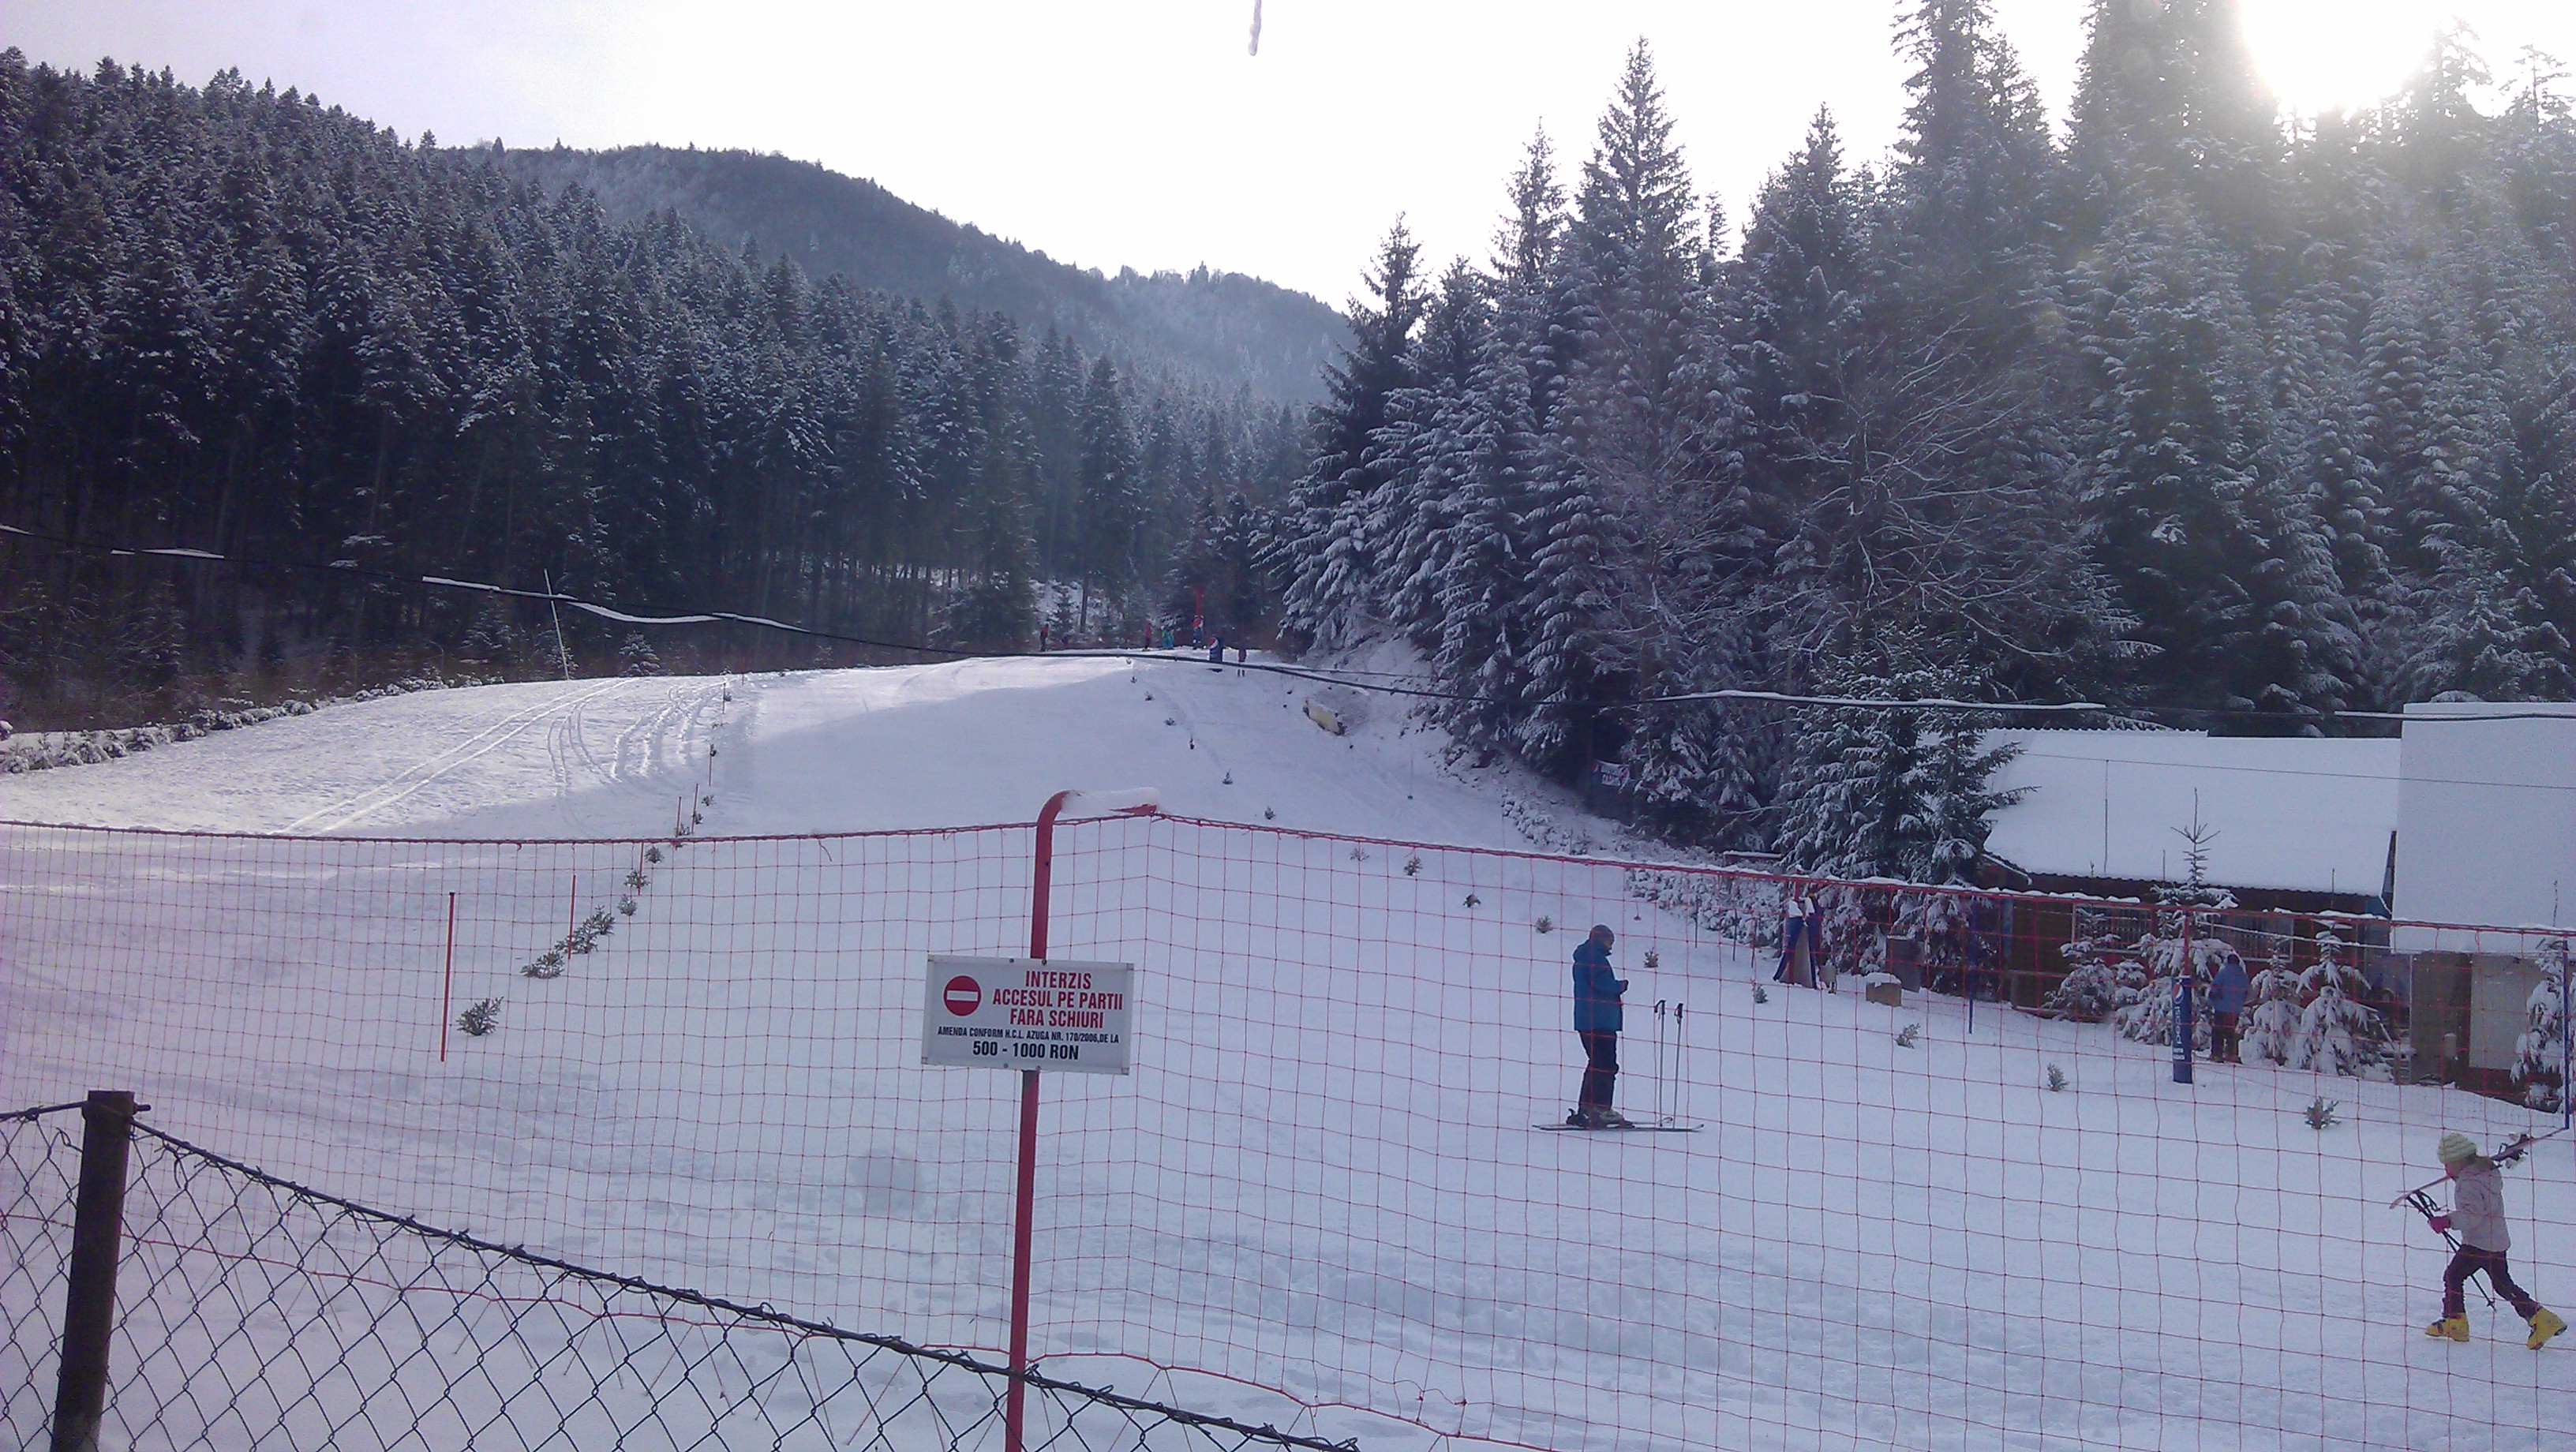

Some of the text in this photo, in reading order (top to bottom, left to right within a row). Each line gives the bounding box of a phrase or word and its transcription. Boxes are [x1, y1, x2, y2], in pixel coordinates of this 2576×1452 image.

[1025, 971, 1091, 990] INTERZIS
[993, 988, 1123, 1010] ACCESUL PE PARTII
[1009, 1009, 1103, 1028] FARA SCHIURI
[938, 1026, 968, 1036] AMENDA
[969, 1027, 1003, 1038] CONFORM
[1005, 1029, 1024, 1039] H.C.L.
[1027, 1030, 1049, 1040] AZUGA
[1051, 1031, 1064, 1041] NR.
[1110, 1034, 1119, 1043] LA
[972, 1040, 998, 1056] 500
[1013, 1042, 1046, 1058] 1000
[1050, 1044, 1079, 1060] RON
